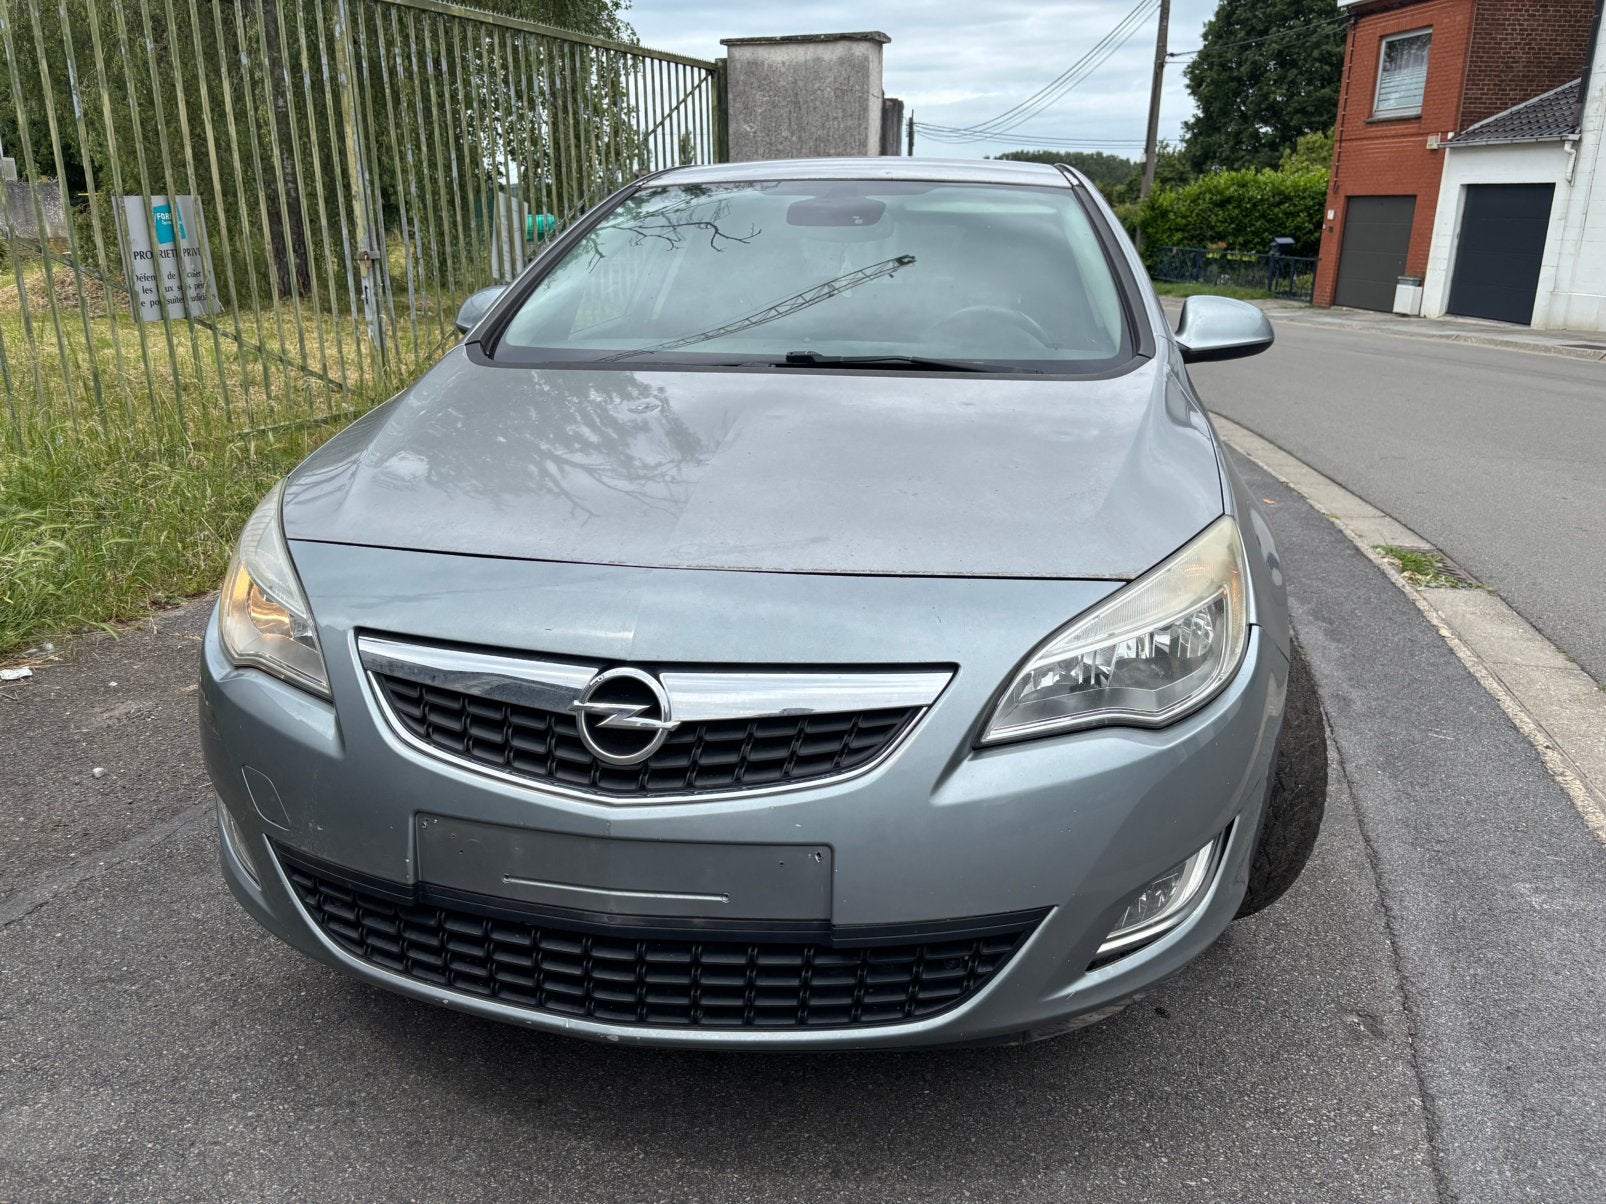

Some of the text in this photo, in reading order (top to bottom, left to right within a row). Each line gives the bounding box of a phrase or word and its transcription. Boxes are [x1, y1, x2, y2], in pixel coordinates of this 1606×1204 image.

[133, 248, 179, 260] PRORIET
[167, 270, 176, 280] de
[141, 285, 154, 295] les
